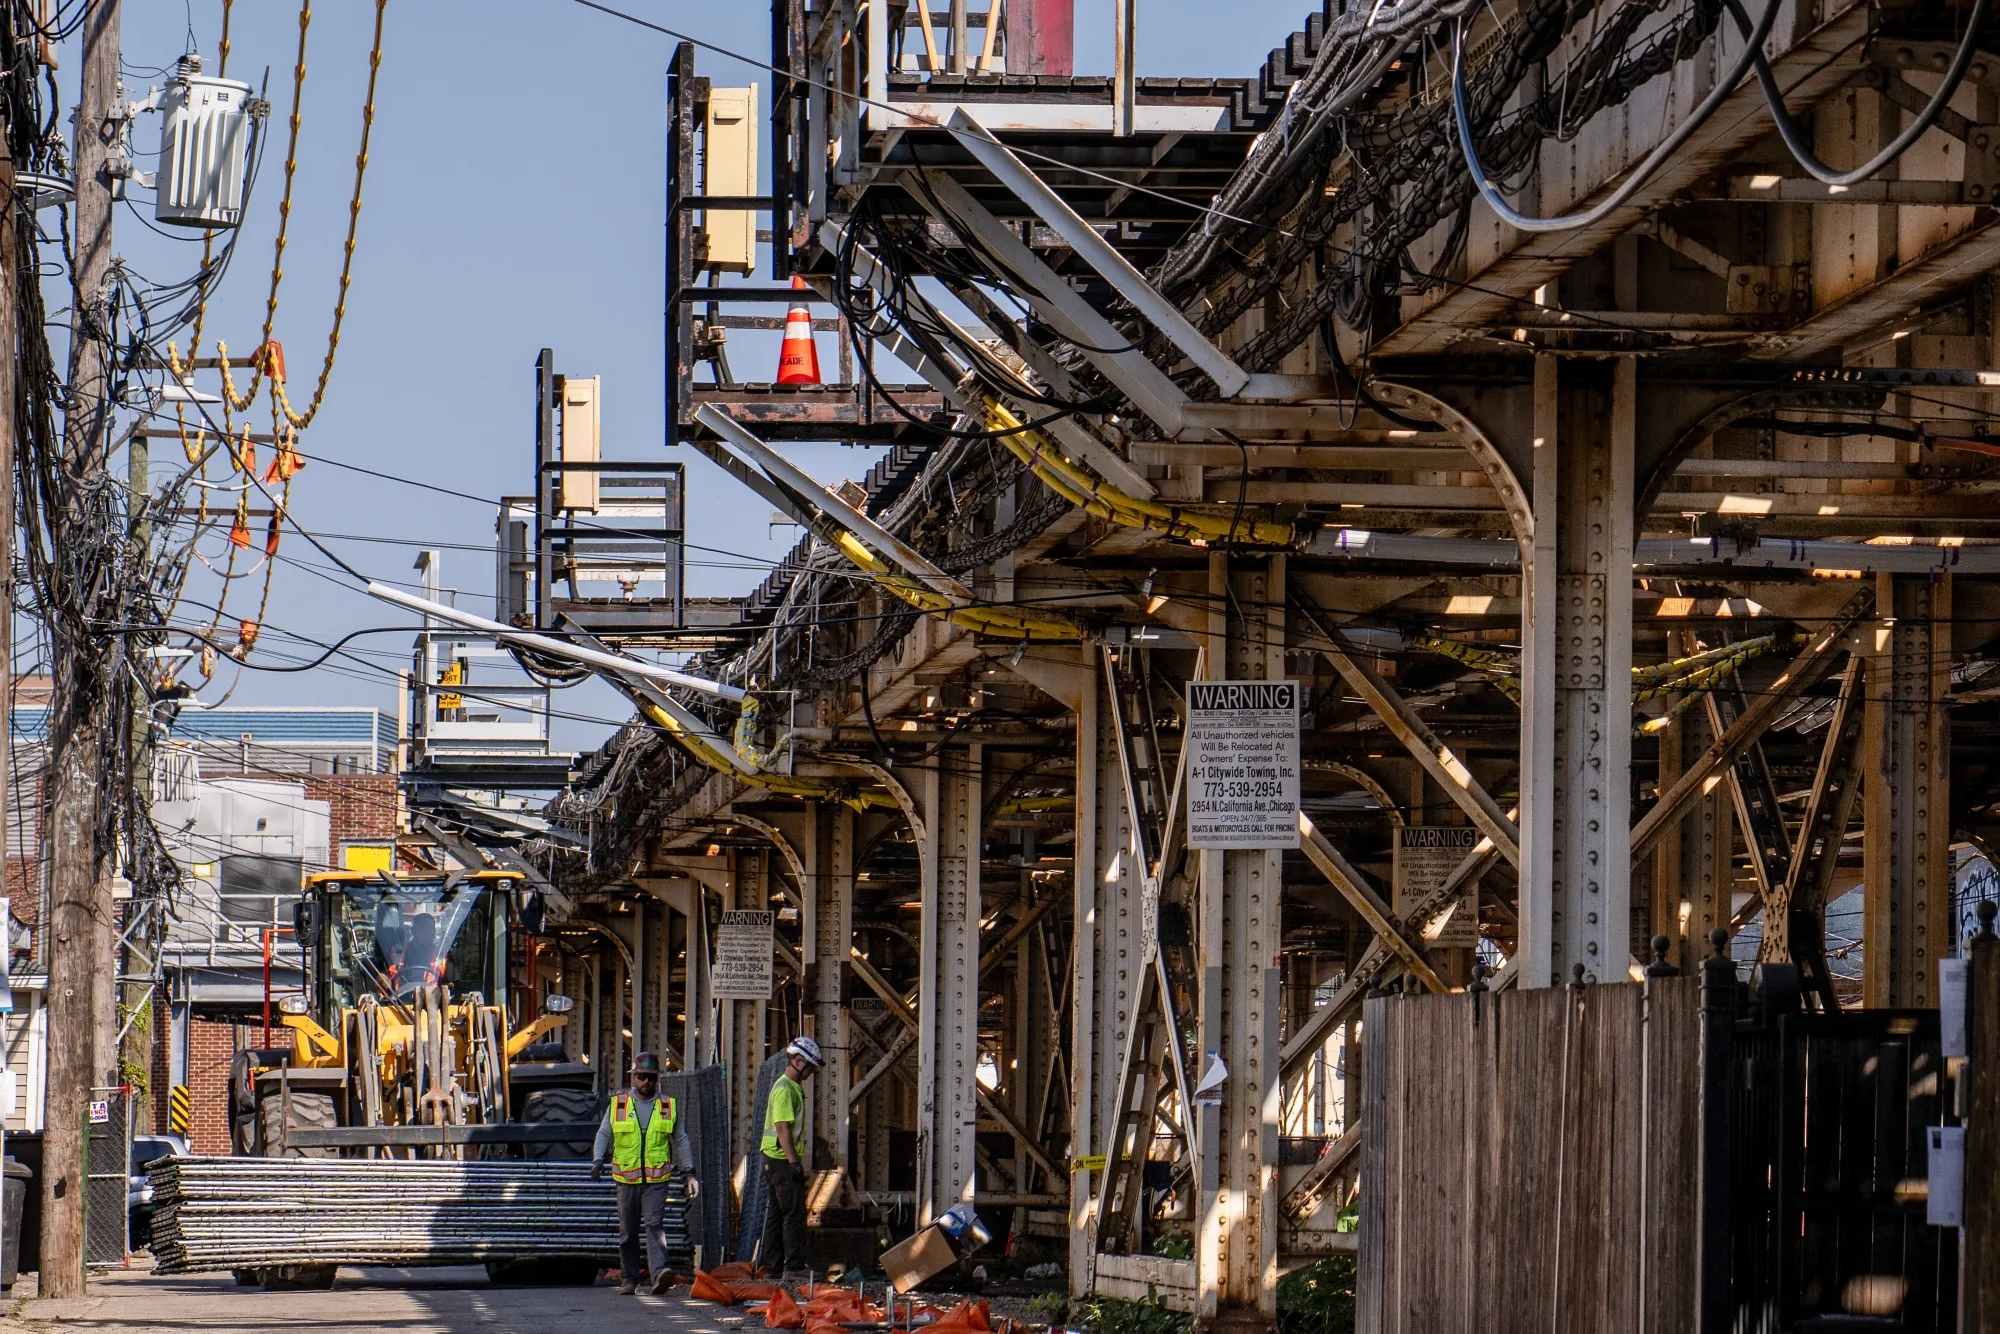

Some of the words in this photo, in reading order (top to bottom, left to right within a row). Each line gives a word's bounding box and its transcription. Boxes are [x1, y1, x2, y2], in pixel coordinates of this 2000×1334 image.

[780, 357, 803, 366] EADE
[1195, 685, 1290, 708] WARNING
[1191, 730, 1202, 740] All
[1204, 730, 1258, 740] Unauthorized
[1260, 730, 1294, 739] vehicles
[1200, 742, 1216, 751] Will
[1218, 742, 1229, 751] Be
[1232, 742, 1272, 751] Relocated
[1275, 742, 1285, 750] At
[1238, 754, 1272, 764] Expense
[1275, 754, 1288, 762] To:
[1192, 766, 1205, 779] A-1
[1208, 766, 1244, 780] Citywide
[1246, 766, 1278, 780] Towing,
[1280, 766, 1295, 777] Inc.
[1204, 782, 1282, 798] 773-539-2954
[1192, 800, 1210, 812] 2954
[1220, 814, 1239, 822] OPEN
[1240, 814, 1267, 822] 24/7/365
[1192, 824, 1208, 833] BOATS
[1214, 824, 1250, 832] MOTORCYCLES
[1251, 824, 1263, 832] CALL
[1404, 830, 1472, 847] WARNING
[1402, 888, 1410, 896] A-1
[720, 912, 770, 925] WARNING
[721, 962, 764, 972] 773-539-2954
